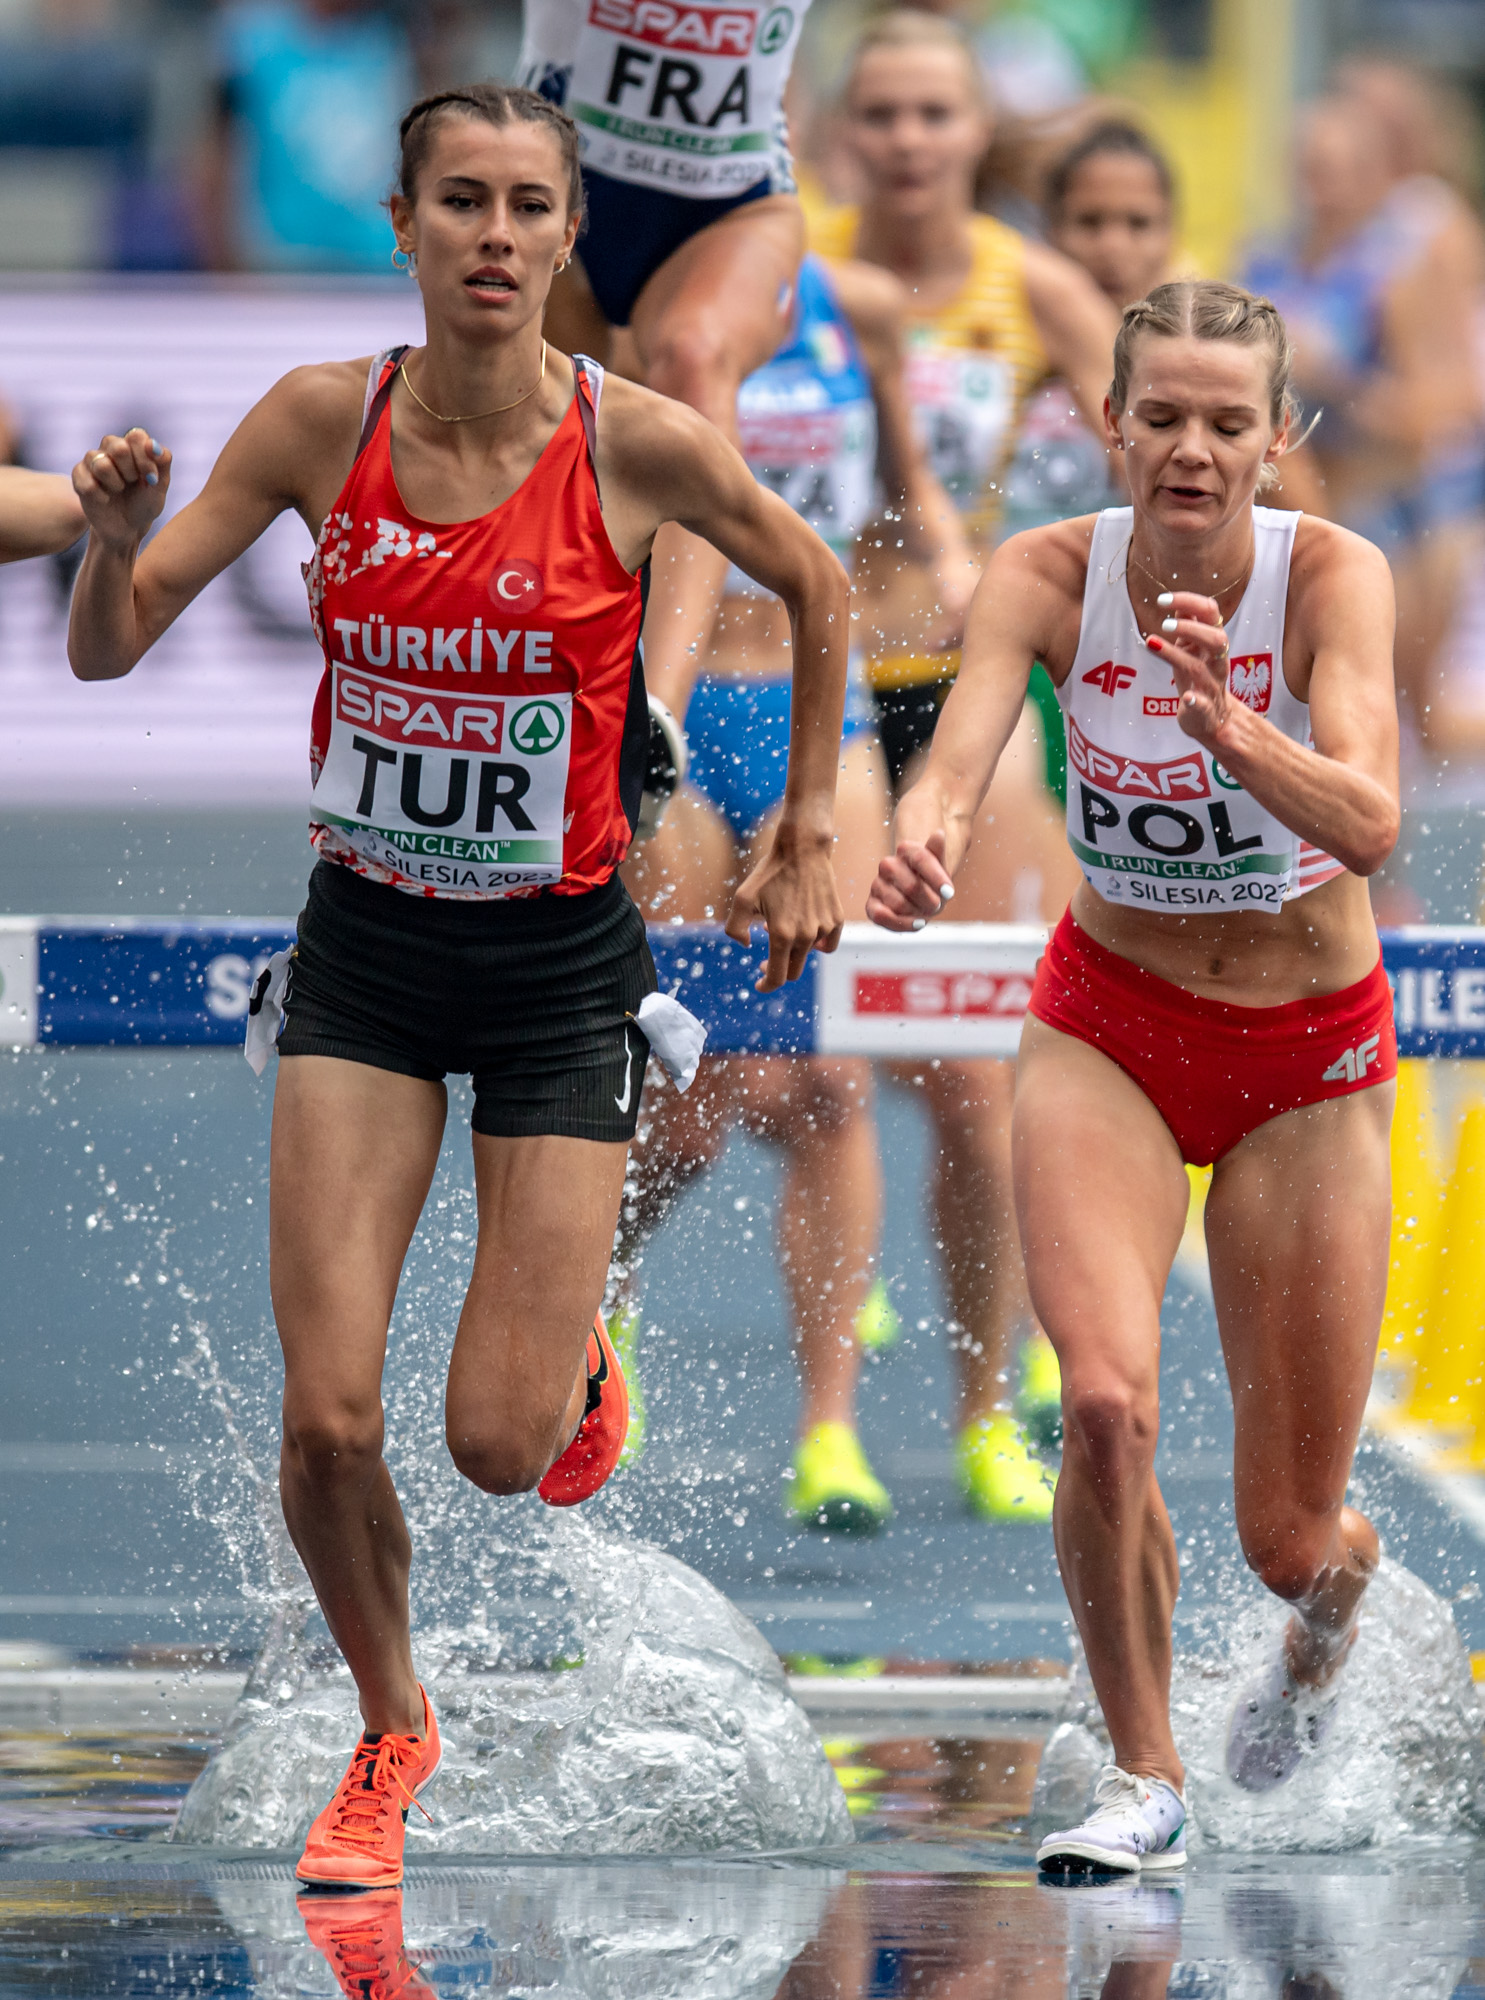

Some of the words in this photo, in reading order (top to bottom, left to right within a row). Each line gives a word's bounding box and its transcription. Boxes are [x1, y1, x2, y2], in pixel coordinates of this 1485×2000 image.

[595, 0, 753, 50] SPAR
[606, 45, 749, 128] FRA
[333, 614, 554, 674] TÜRKİYE
[1081, 660, 1138, 698] 4F
[340, 677, 498, 746] SPAR
[1145, 699, 1180, 714] ORL
[352, 733, 538, 833] TUR
[1070, 724, 1205, 796] SPAR
[1079, 780, 1264, 858] POL
[384, 849, 481, 888] SILESIA
[1100, 854, 1108, 867] I
[1112, 855, 1159, 875] RUN
[1130, 880, 1226, 904] SILESIA
[903, 975, 1033, 1015] SPA
[1391, 967, 1485, 1032] ILE
[1321, 1033, 1381, 1083] 4F
